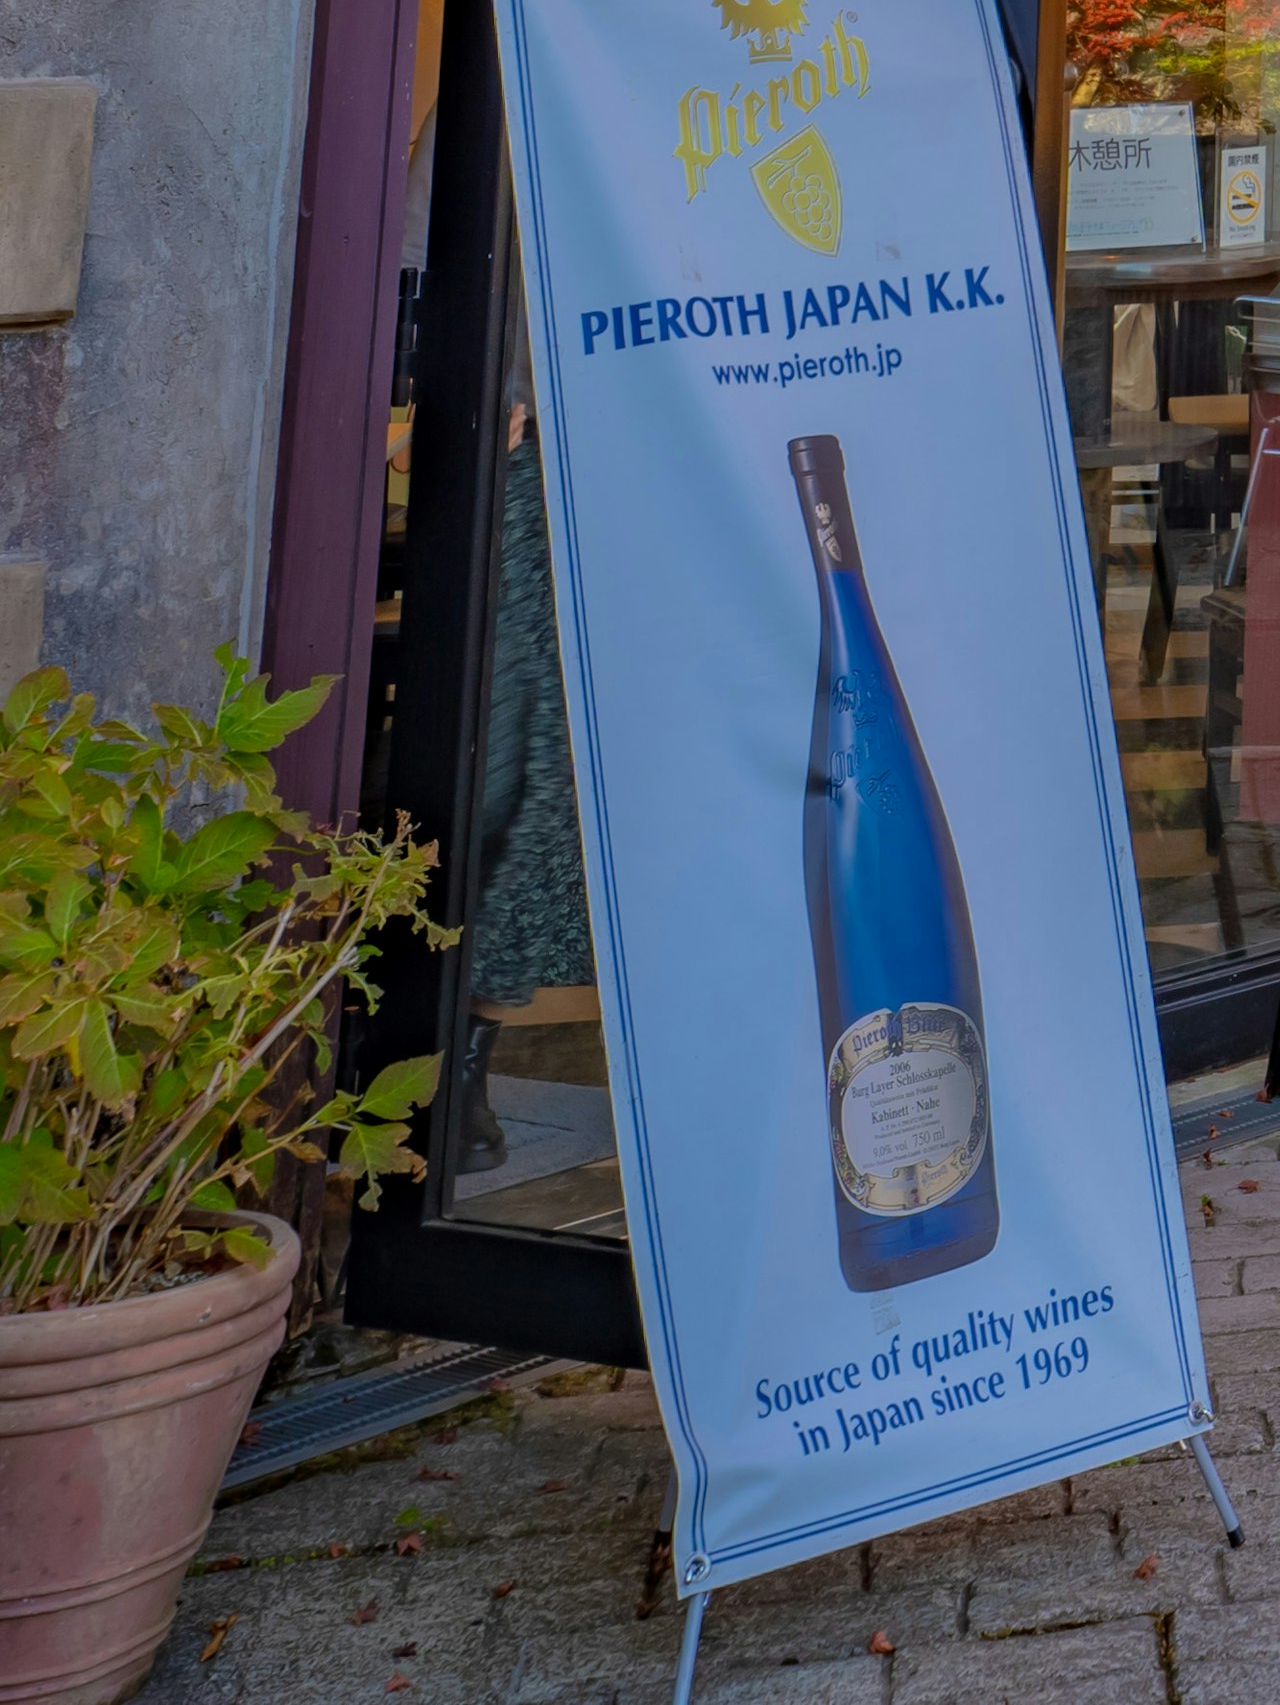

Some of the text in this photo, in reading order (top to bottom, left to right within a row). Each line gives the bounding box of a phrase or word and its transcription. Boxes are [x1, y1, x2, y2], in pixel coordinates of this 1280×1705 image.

[671, 8, 872, 205] Pieroth
[580, 265, 1006, 356] PIEROTH JAPAN K.K.
[711, 342, 903, 389] www.pieroth.jp
[890, 1061, 912, 1077] 2006
[871, 1105, 910, 1125] Kabinett
[916, 1097, 941, 1113] Nahe
[912, 1130, 932, 1147] 750
[756, 1285, 1116, 1420] Source of quality wines
[792, 1336, 1091, 1457] in Japan since 1969
